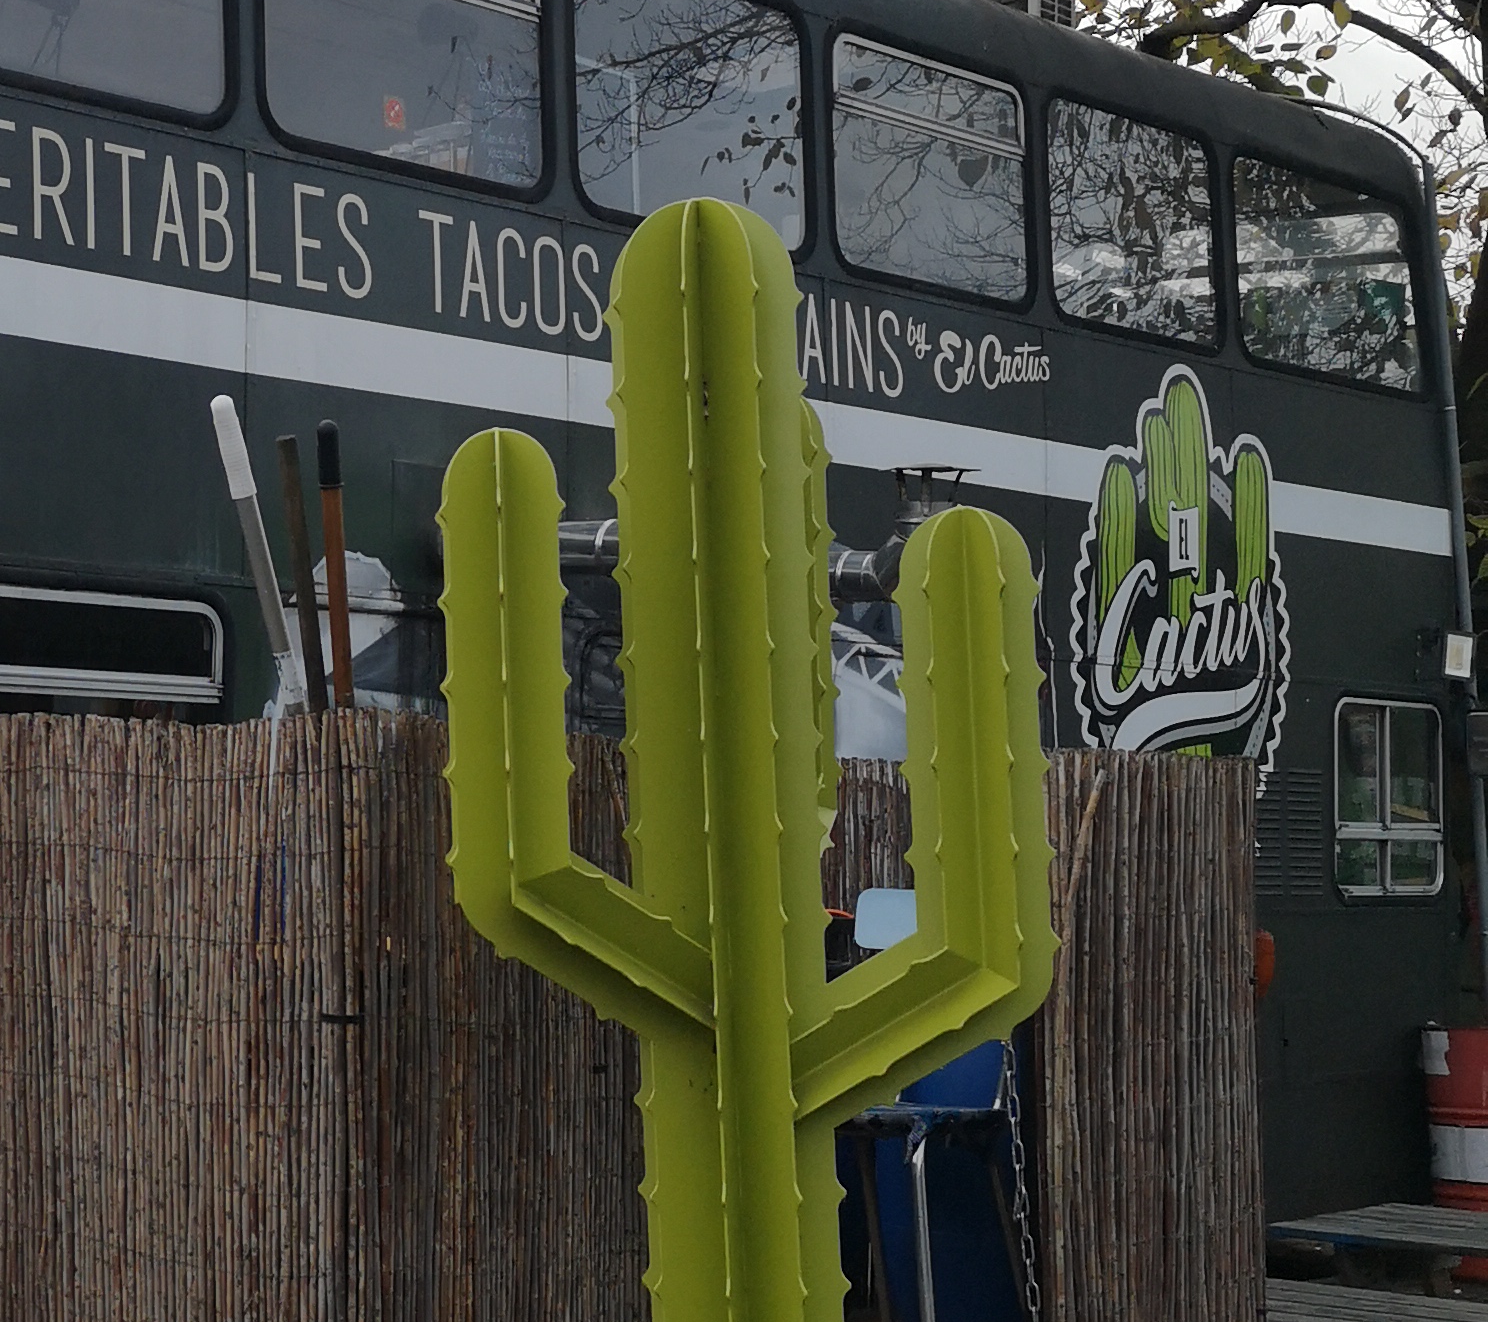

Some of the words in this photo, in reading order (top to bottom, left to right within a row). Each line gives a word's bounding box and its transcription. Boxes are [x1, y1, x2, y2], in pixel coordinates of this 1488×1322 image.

[418, 209, 604, 342] TACOS
[907, 316, 932, 360] by
[934, 330, 976, 393] El
[979, 334, 1051, 390] Cactus
[1178, 518, 1190, 561] EL
[1095, 559, 1265, 706] Cactus
